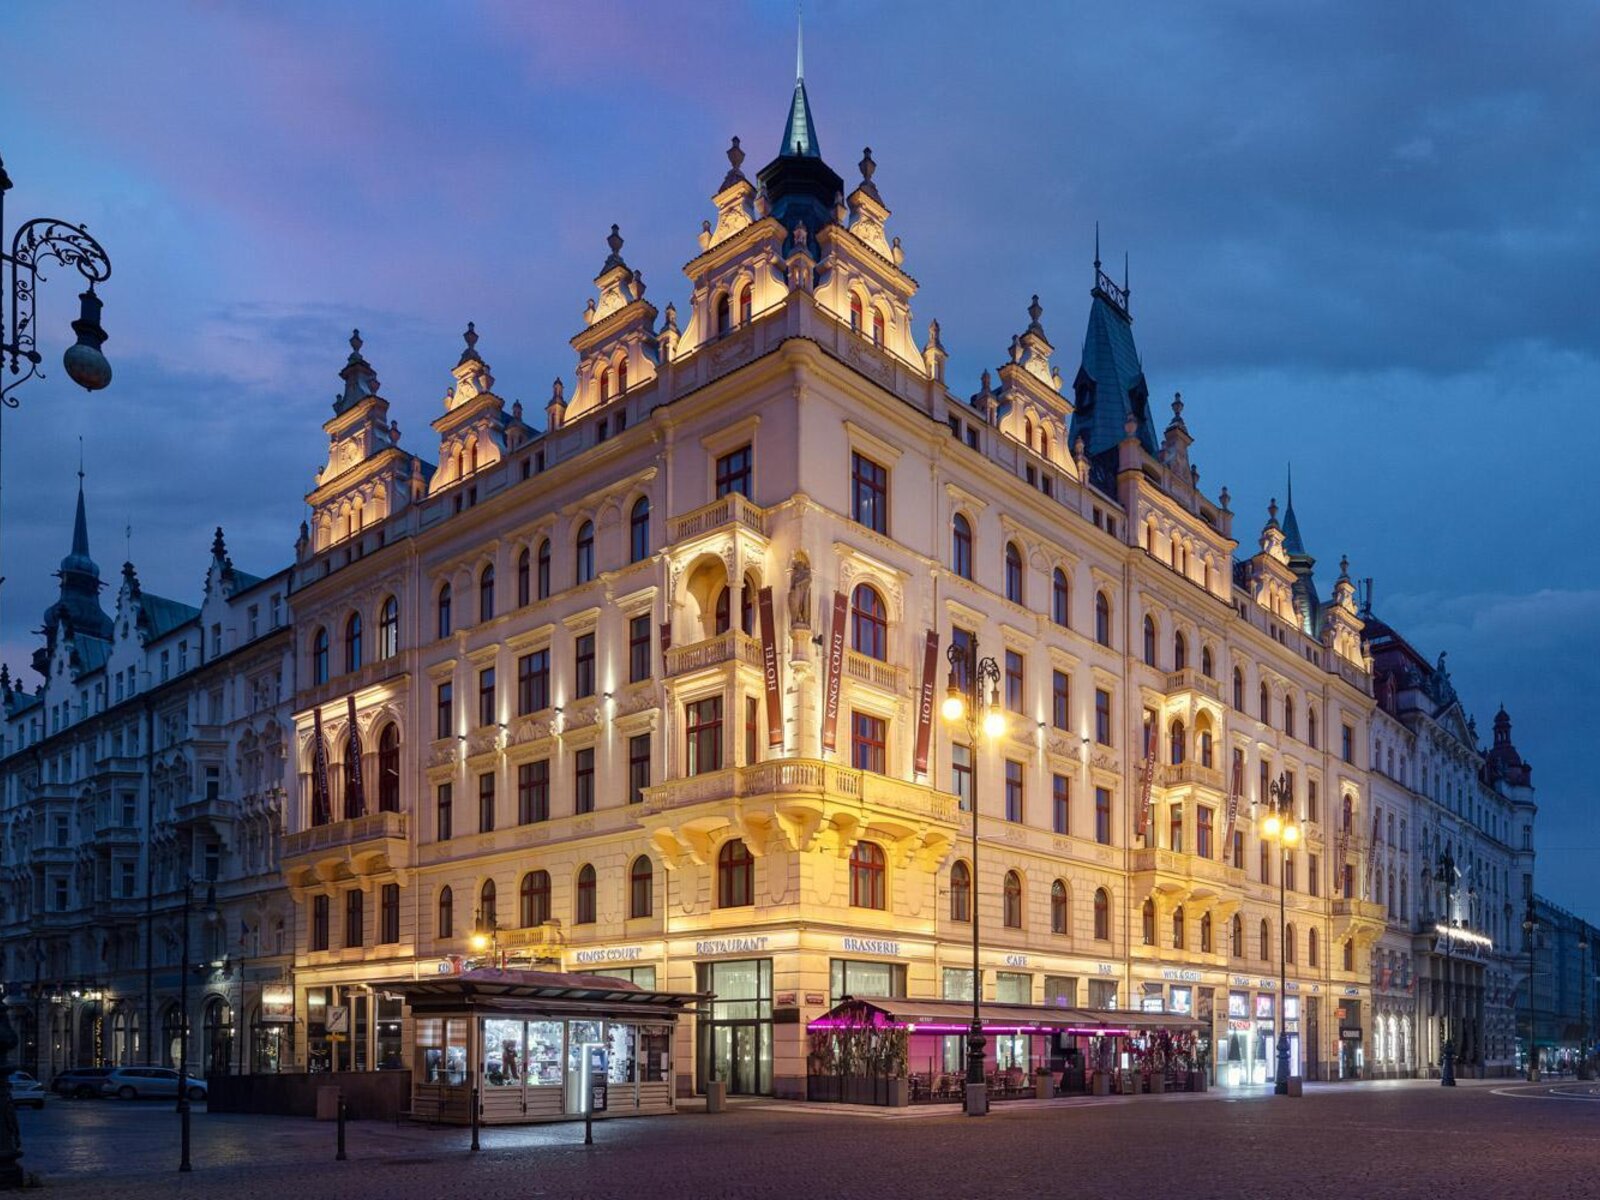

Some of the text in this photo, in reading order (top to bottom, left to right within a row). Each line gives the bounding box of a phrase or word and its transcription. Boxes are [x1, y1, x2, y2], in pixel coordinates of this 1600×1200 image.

[765, 642, 777, 692] HOTEL
[828, 632, 843, 719] KINGS COURT
[921, 681, 933, 725] HOTEL
[695, 936, 768, 954] RESTAURANT
[844, 937, 901, 954] BRASSERIE
[576, 946, 642, 963] KINGS COURT
[1098, 963, 1112, 975] BAR
